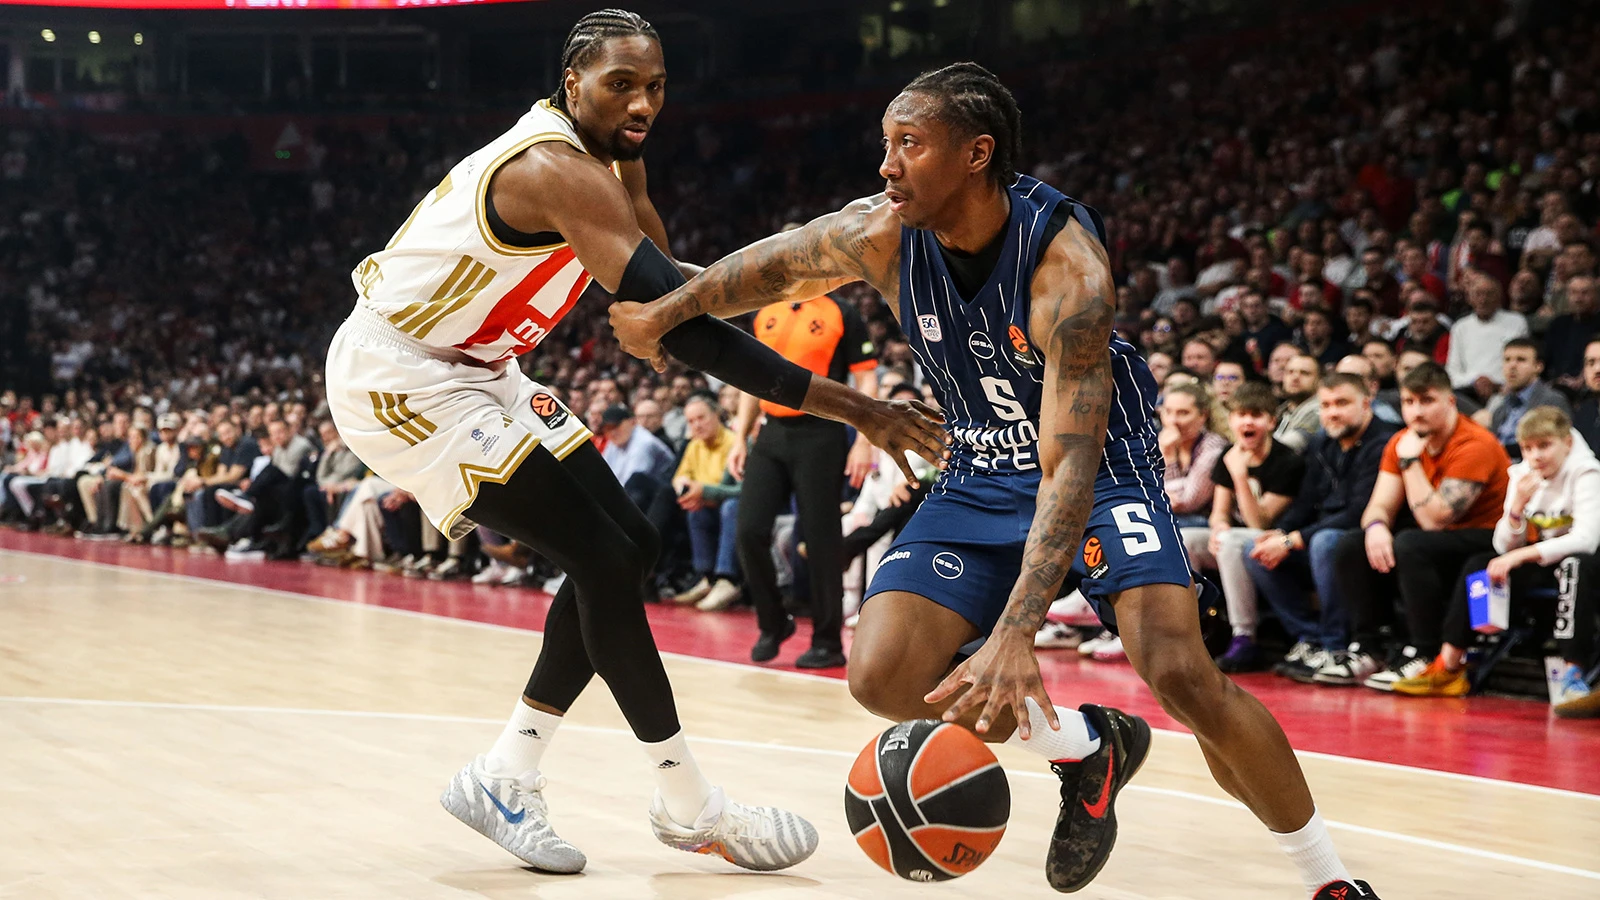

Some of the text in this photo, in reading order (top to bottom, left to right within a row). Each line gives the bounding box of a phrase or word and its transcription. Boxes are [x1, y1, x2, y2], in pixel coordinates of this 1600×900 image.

[921, 317, 937, 329] 50
[971, 339, 993, 350] GSA
[979, 376, 1027, 421] 5
[971, 445, 1038, 471] EFE
[1110, 502, 1162, 557] 5
[935, 558, 961, 573] GSA
